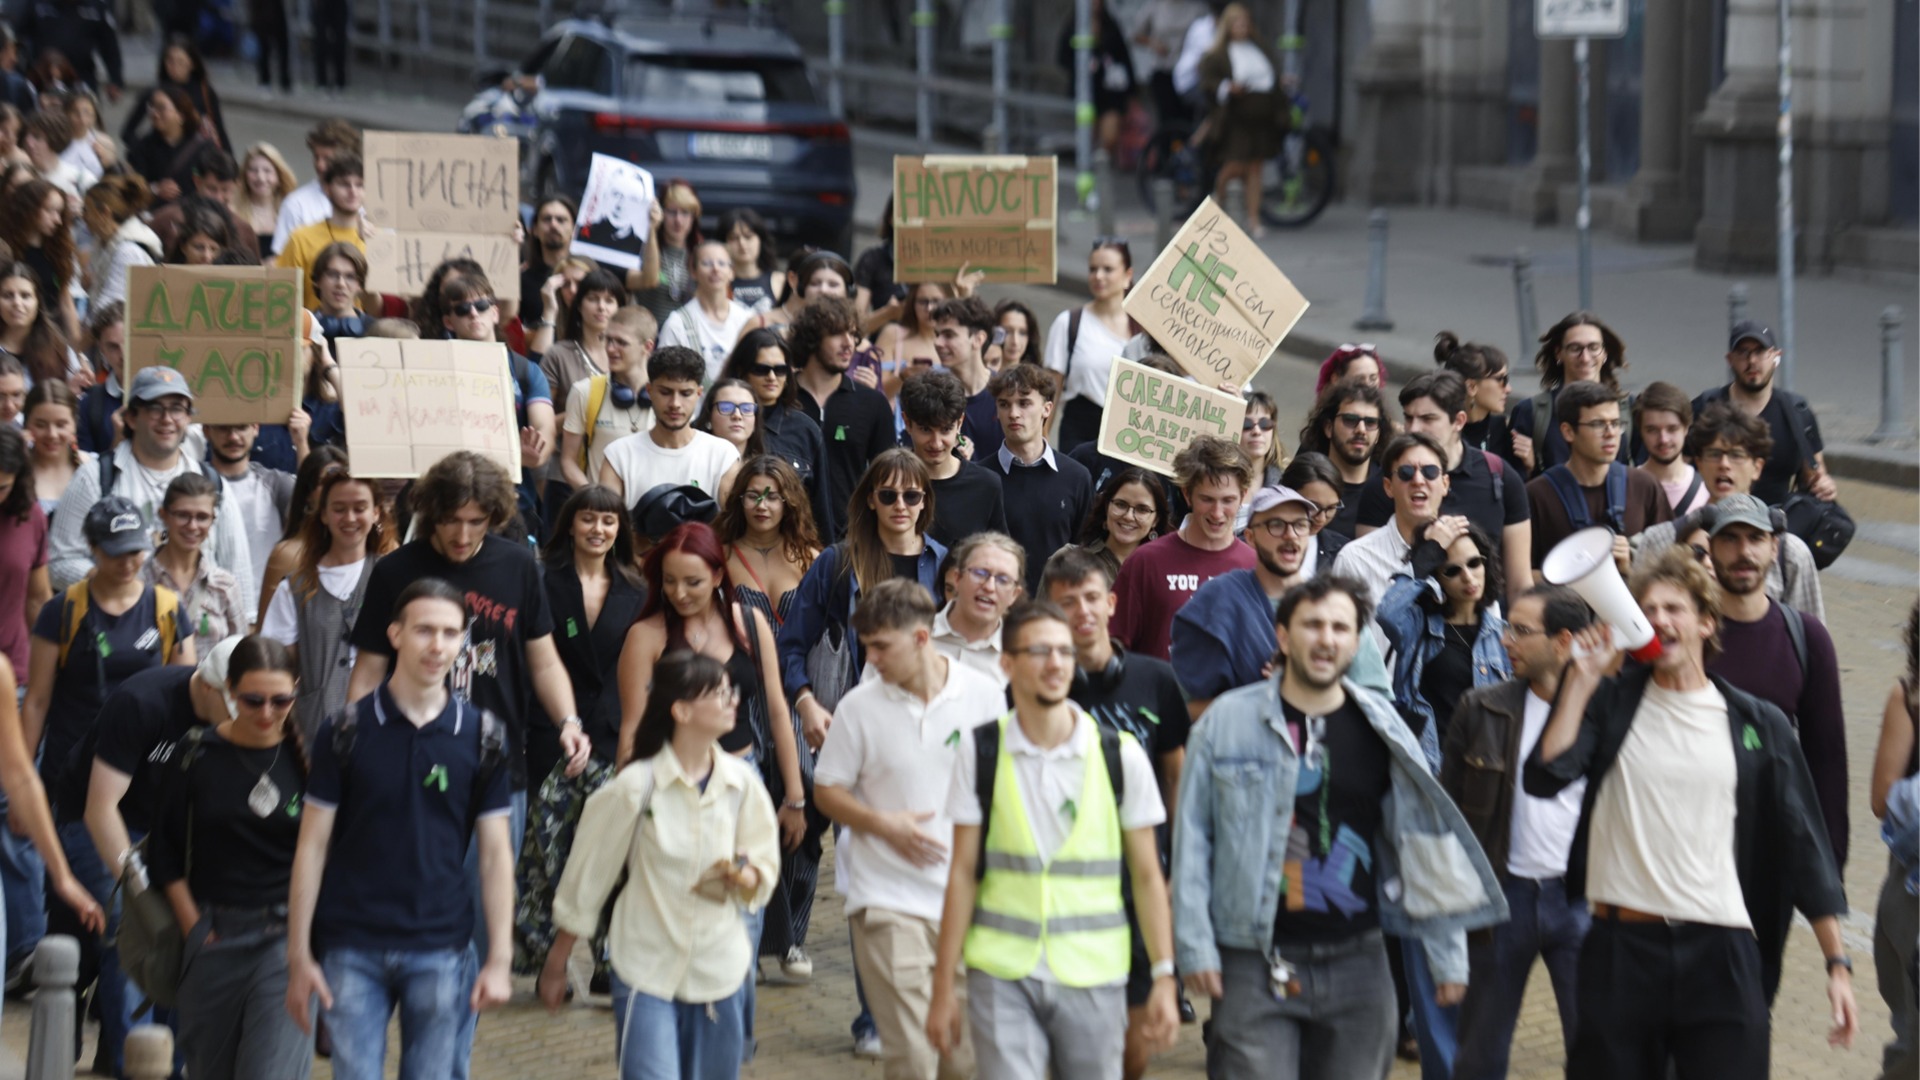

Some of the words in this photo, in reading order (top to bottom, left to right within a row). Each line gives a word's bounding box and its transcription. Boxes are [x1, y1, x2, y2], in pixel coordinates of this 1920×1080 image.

[376, 157, 512, 212] ПИСНА
[900, 171, 1049, 222] НАГЛОСТ
[1196, 214, 1230, 256] АЗ
[1167, 241, 1238, 316] НЕ
[1162, 318, 1236, 380] такса
[1116, 369, 1227, 435] СЛЕДВАЩ
[1115, 427, 1175, 462] ОСТ
[1166, 574, 1199, 591] YOU
